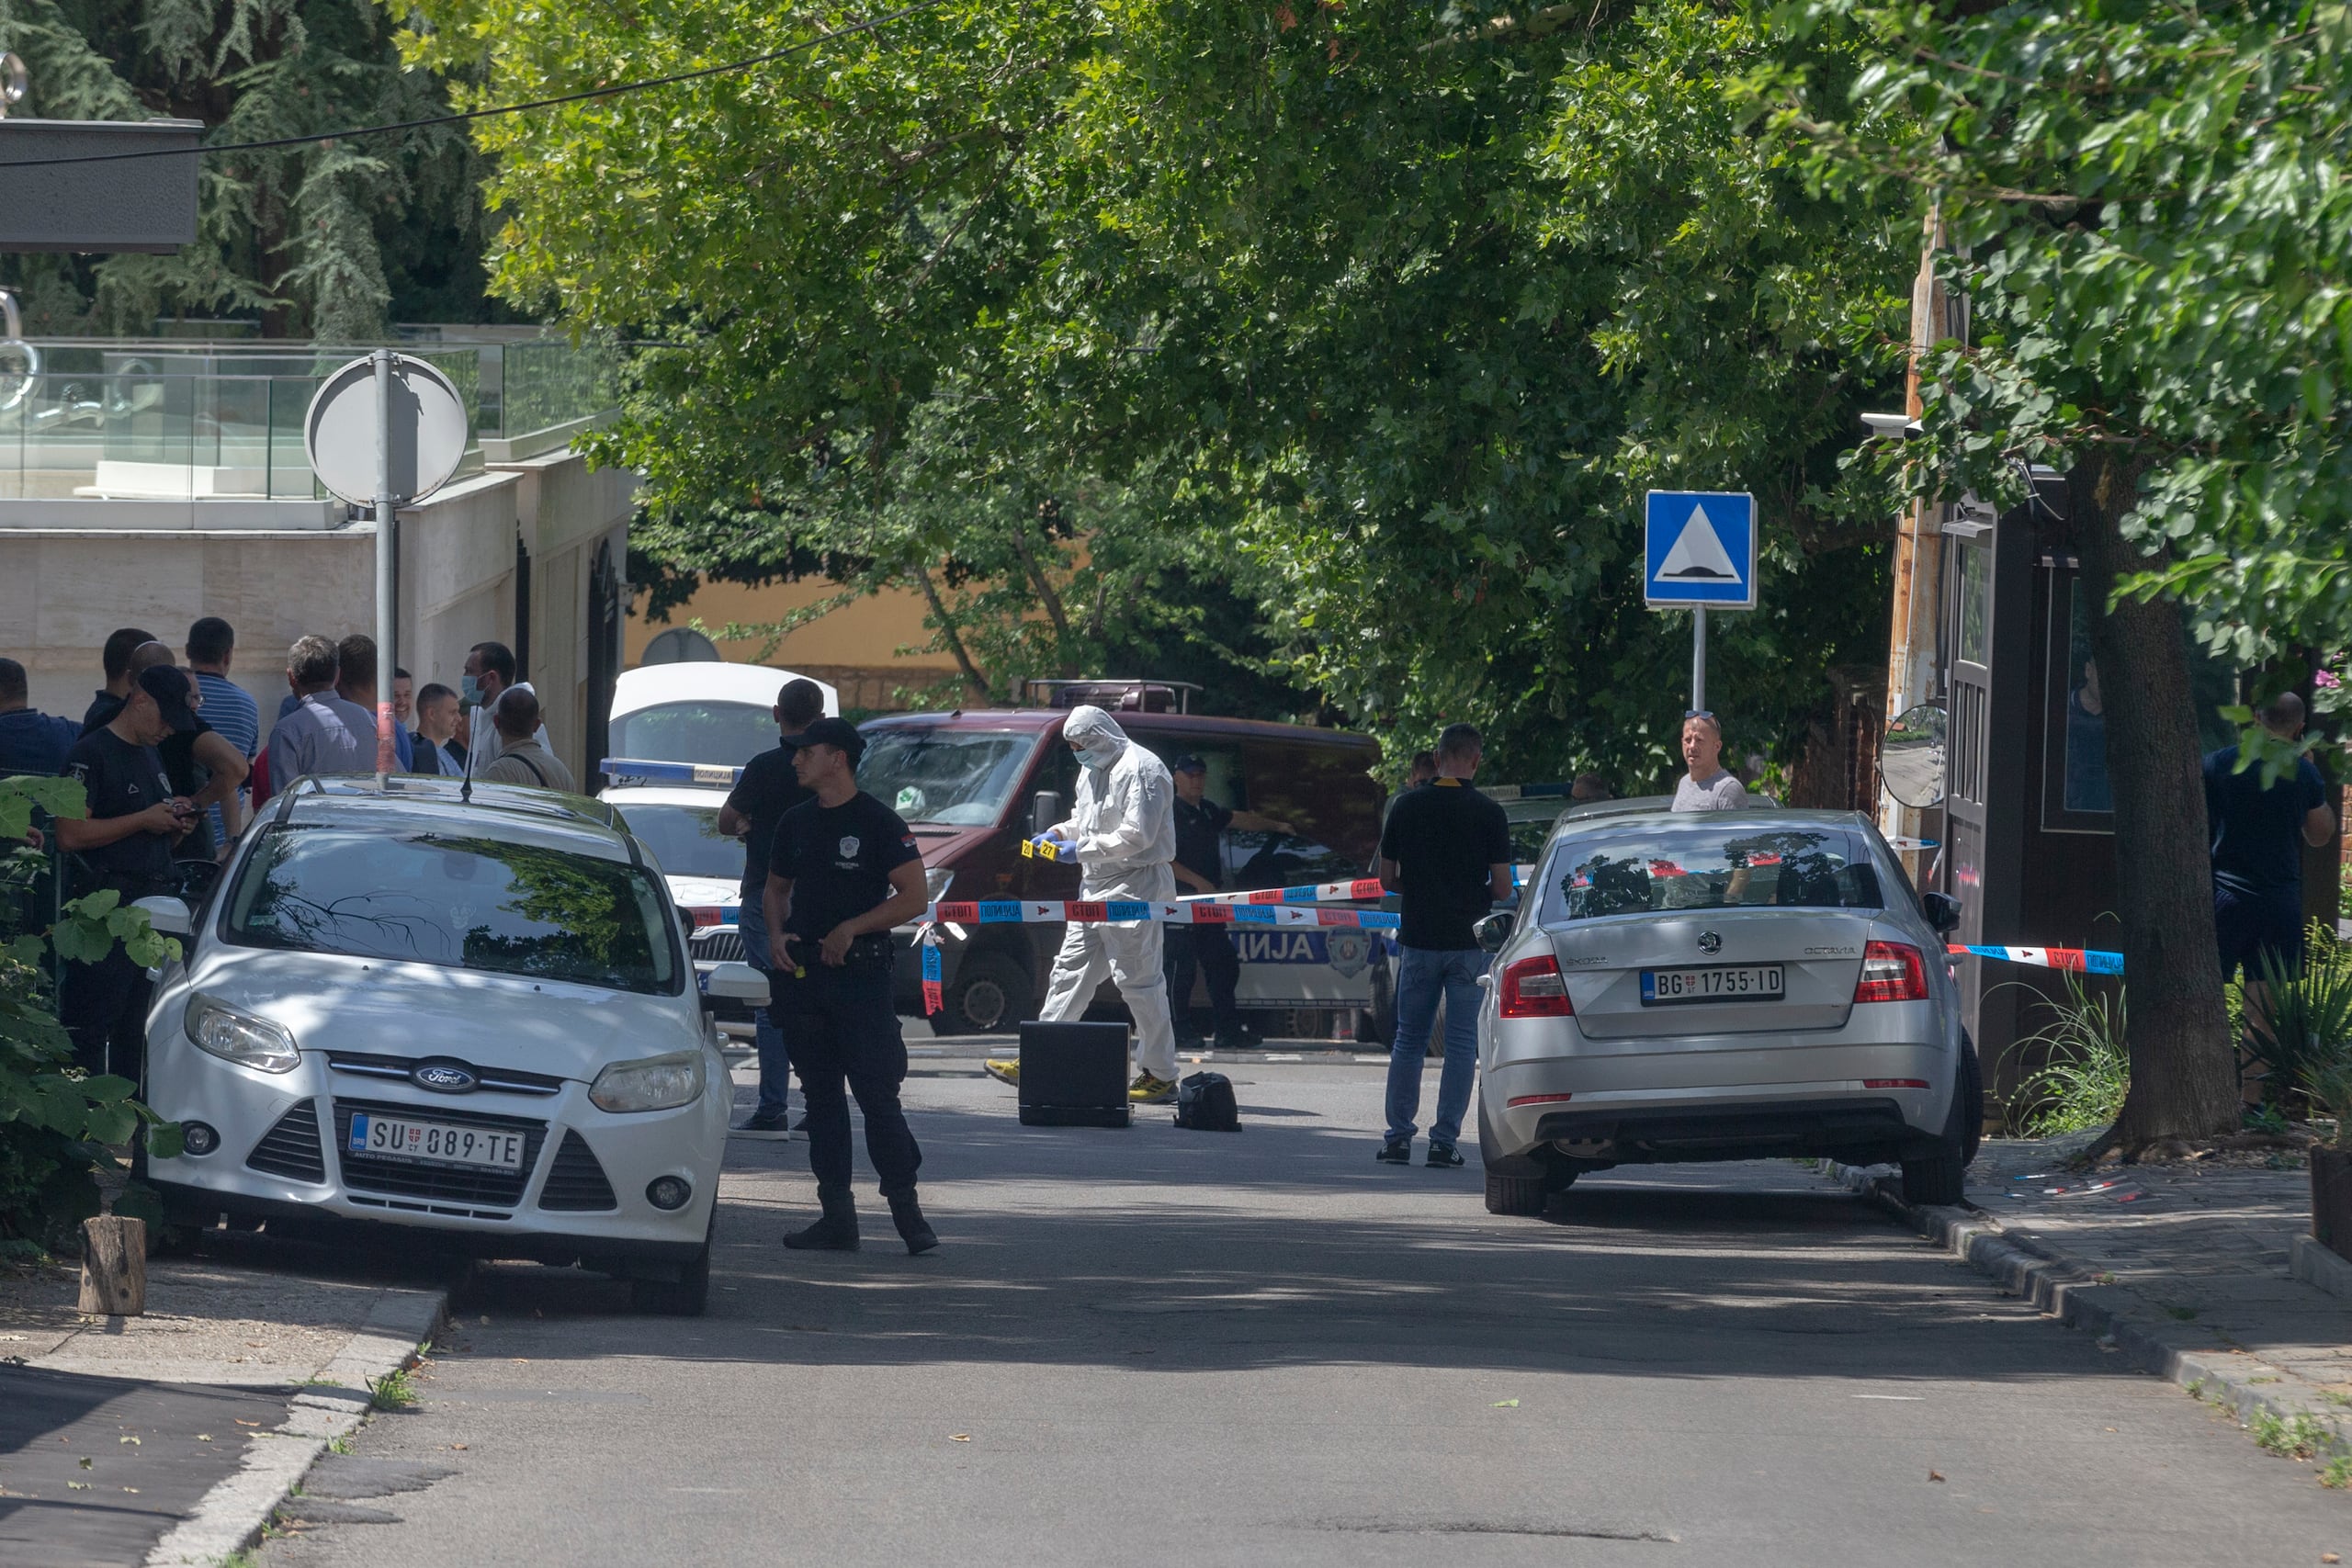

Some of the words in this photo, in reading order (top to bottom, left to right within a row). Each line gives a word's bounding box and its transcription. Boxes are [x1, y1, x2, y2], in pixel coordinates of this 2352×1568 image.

[695, 770, 731, 780] ПОЛИЦИЈА
[1042, 843, 1053, 856] 27
[1357, 881, 1379, 895] СТОП
[944, 905, 971, 918] СТОП
[981, 905, 1021, 918] ПОЛИЦИЈА
[1072, 904, 1100, 917] СТОП
[1109, 904, 1149, 918] ПОЛИЦИЈА
[1199, 907, 1227, 919] СТОП
[1235, 907, 1275, 919] ПОЛИЦИЈА
[2053, 951, 2079, 964] СТОП
[1658, 975, 1682, 995] BG
[428, 1068, 460, 1084] Ford
[373, 1122, 405, 1150] SU
